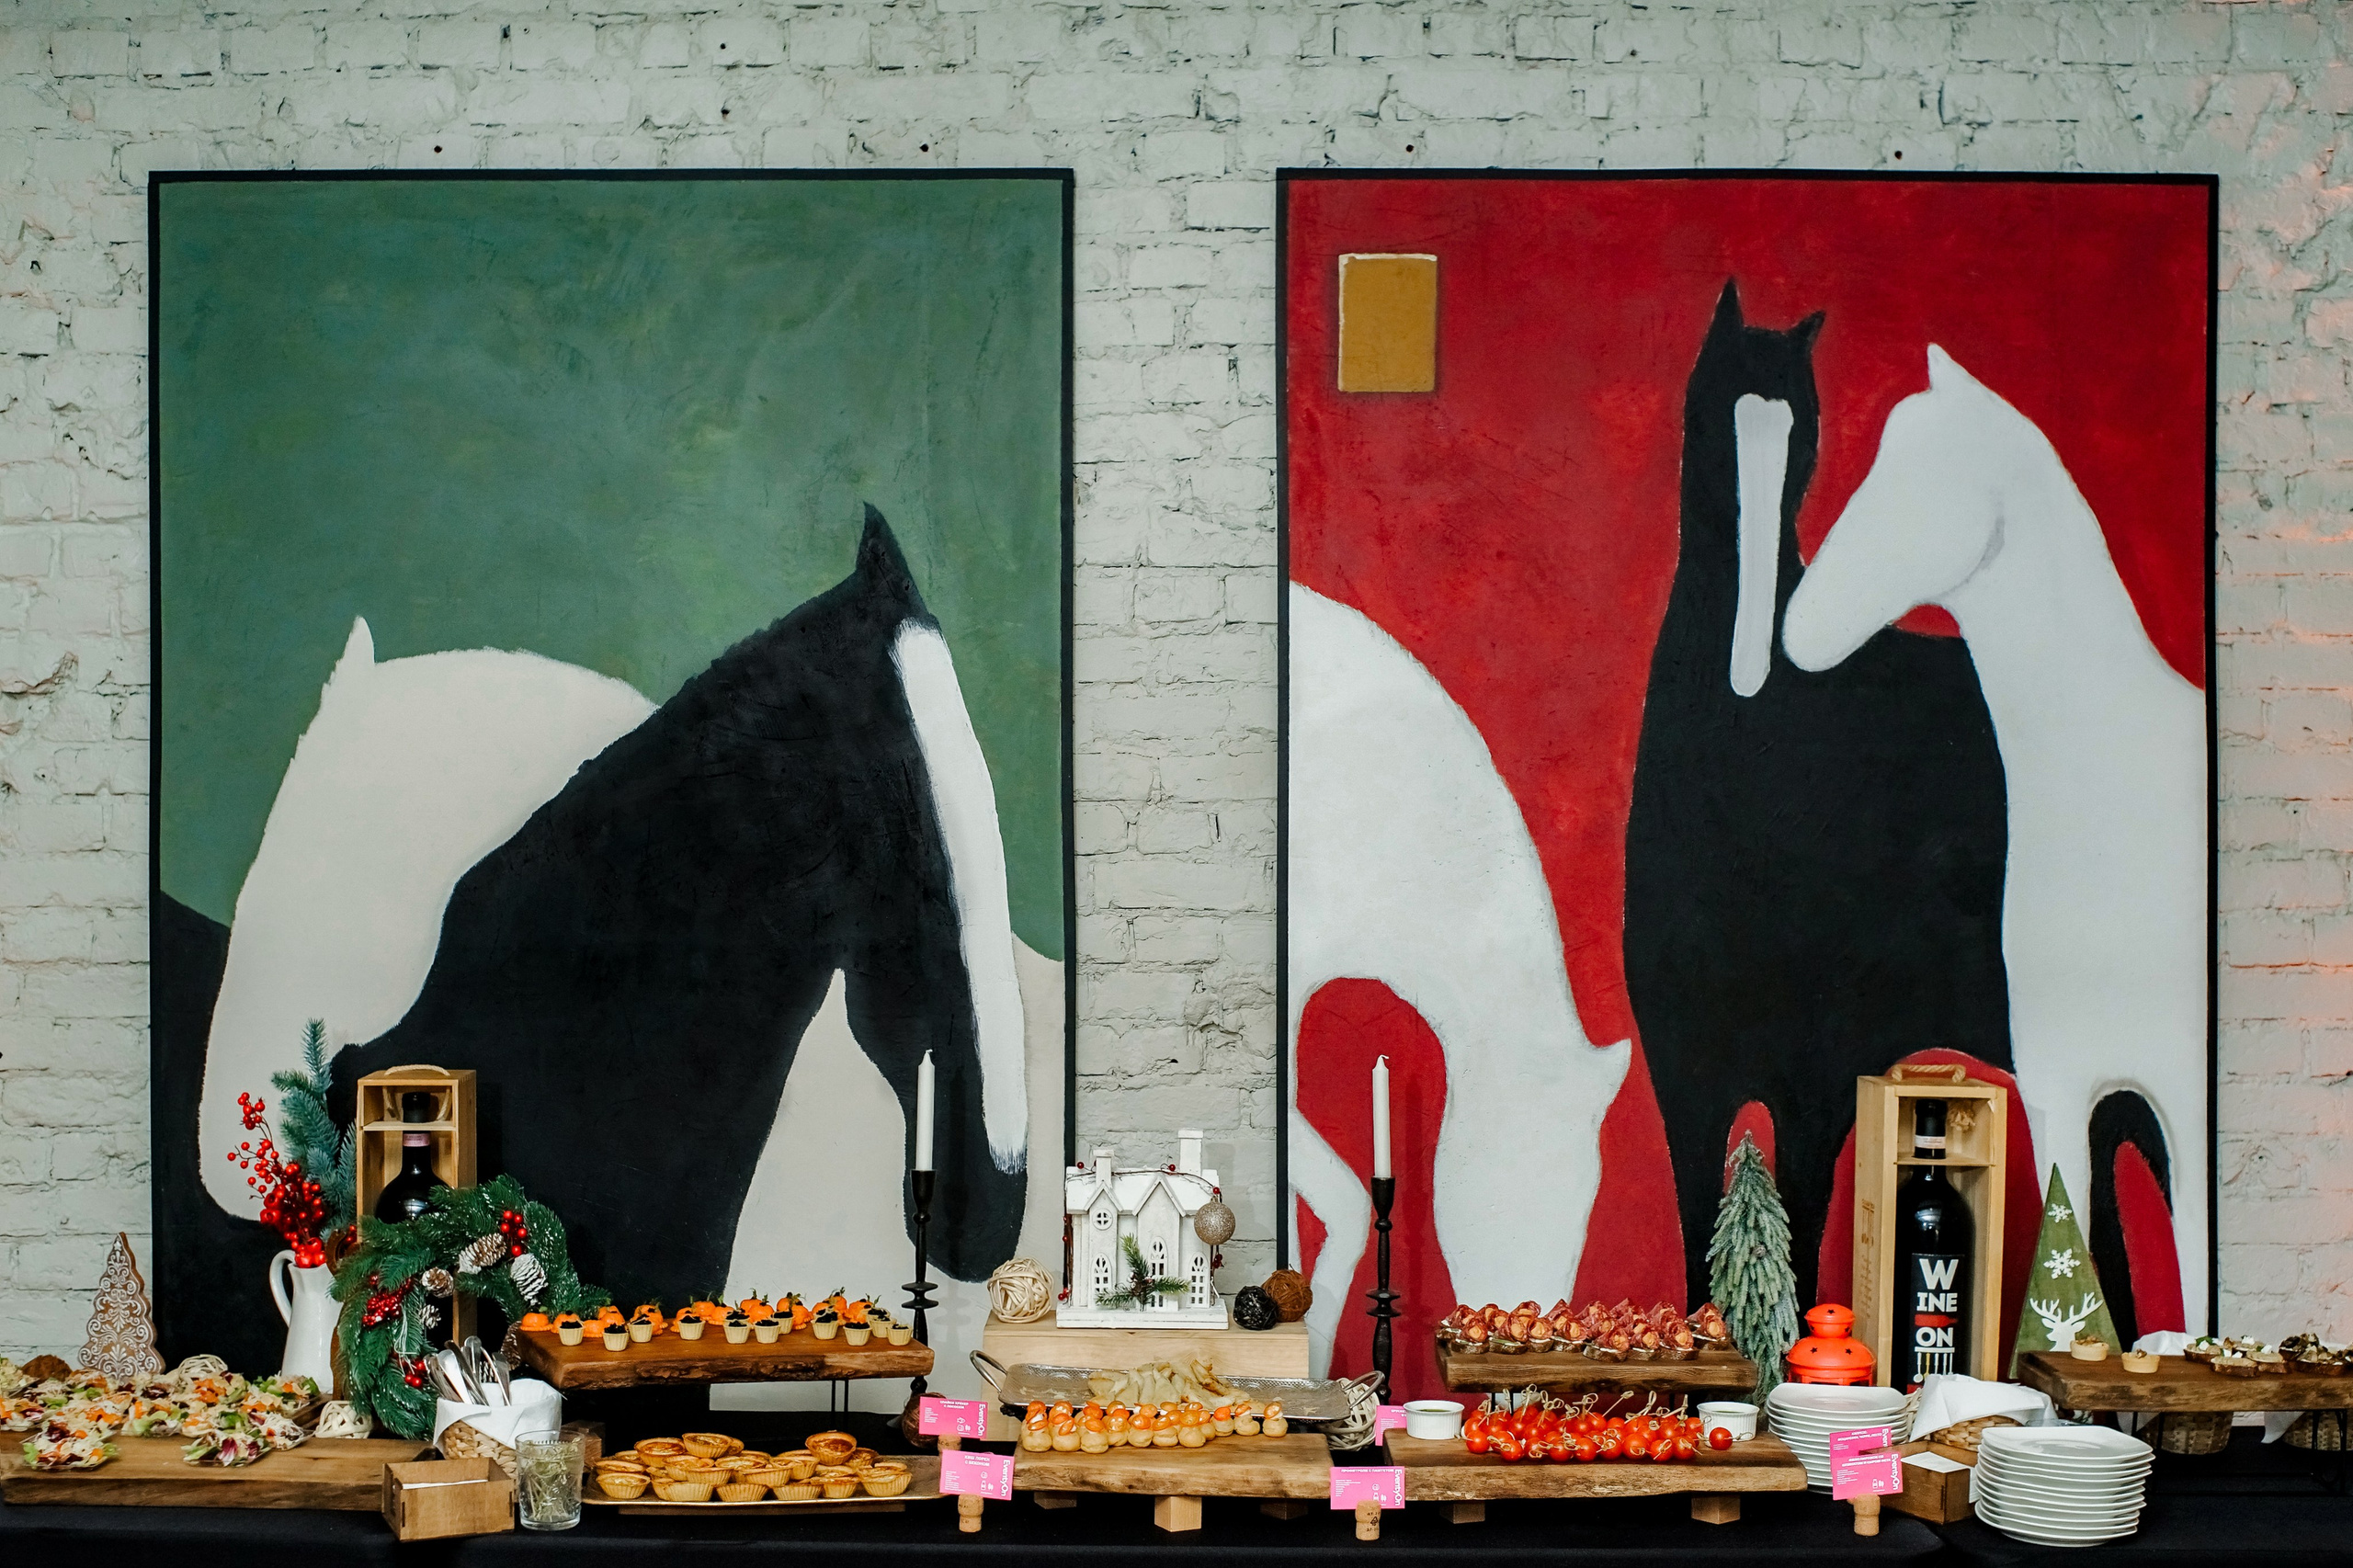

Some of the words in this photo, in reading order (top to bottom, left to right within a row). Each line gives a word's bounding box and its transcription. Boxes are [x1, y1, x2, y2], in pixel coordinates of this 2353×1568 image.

[1915, 1326, 1954, 1347] ON
[977, 1403, 986, 1437] EventyOn
[1000, 1460, 1011, 1496] EventyOn
[1392, 1469, 1403, 1506] EventyOn
[1891, 1453, 1900, 1490] EventyOn
